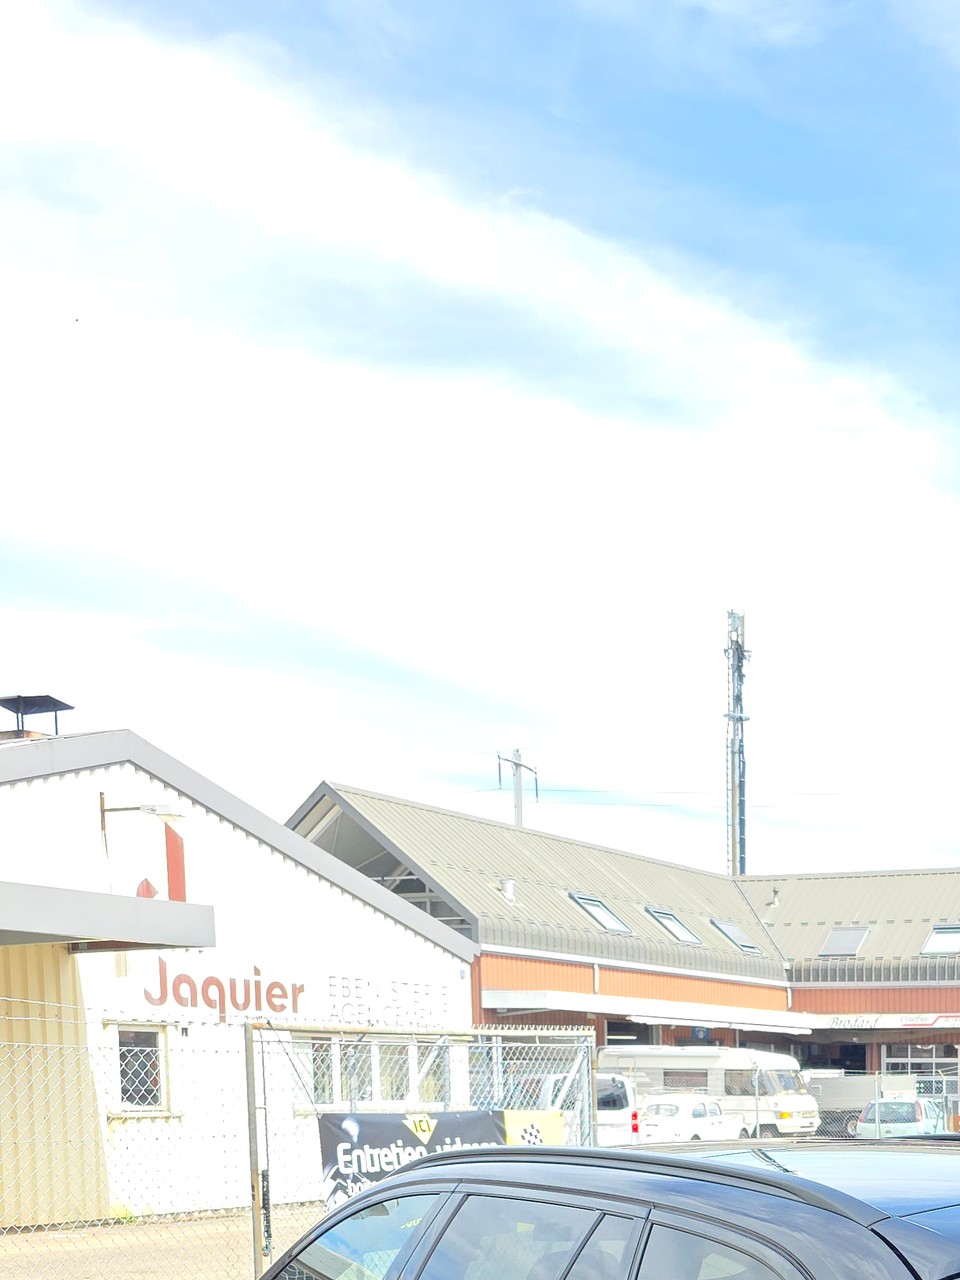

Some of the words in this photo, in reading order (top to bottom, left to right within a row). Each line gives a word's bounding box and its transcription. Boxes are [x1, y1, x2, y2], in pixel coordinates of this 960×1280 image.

[143, 956, 305, 1024] Jaquier
[827, 1014, 882, 1029] Brodard
[336, 1138, 428, 1175] Entretien
